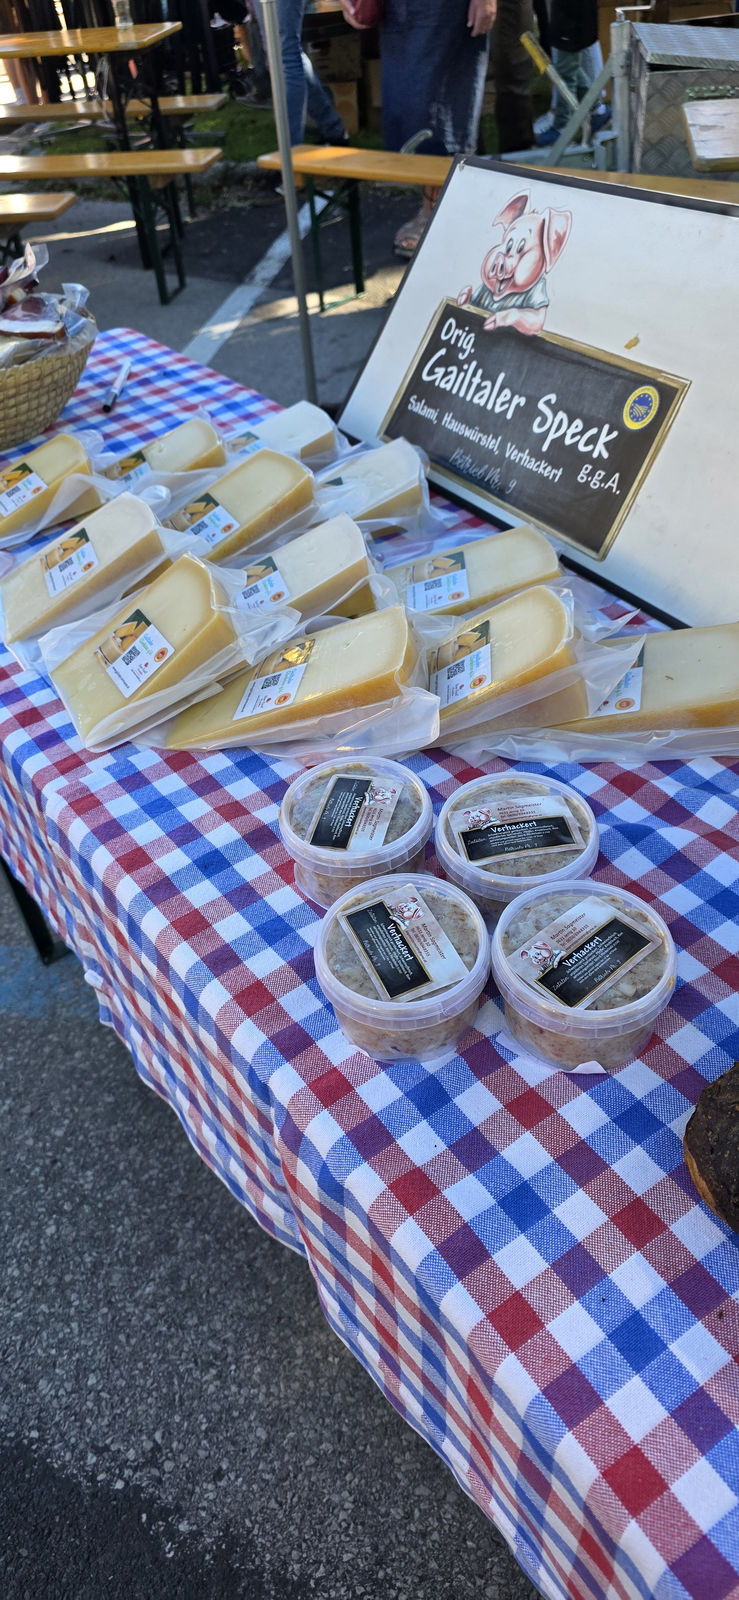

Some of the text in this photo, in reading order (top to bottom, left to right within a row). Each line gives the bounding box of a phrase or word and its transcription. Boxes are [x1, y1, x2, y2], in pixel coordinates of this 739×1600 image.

[440, 317, 475, 358] Orig.
[421, 348, 525, 420] Gailtaler
[532, 392, 619, 460] Speck
[407, 395, 563, 482] Salami, Hauswürstel, Verhackert
[577, 462, 621, 495] g.g.A.
[345, 797, 362, 826] Verhackert
[491, 821, 536, 833] Verhackert
[387, 923, 413, 961] Verhackert
[563, 937, 601, 967] Verhackert
